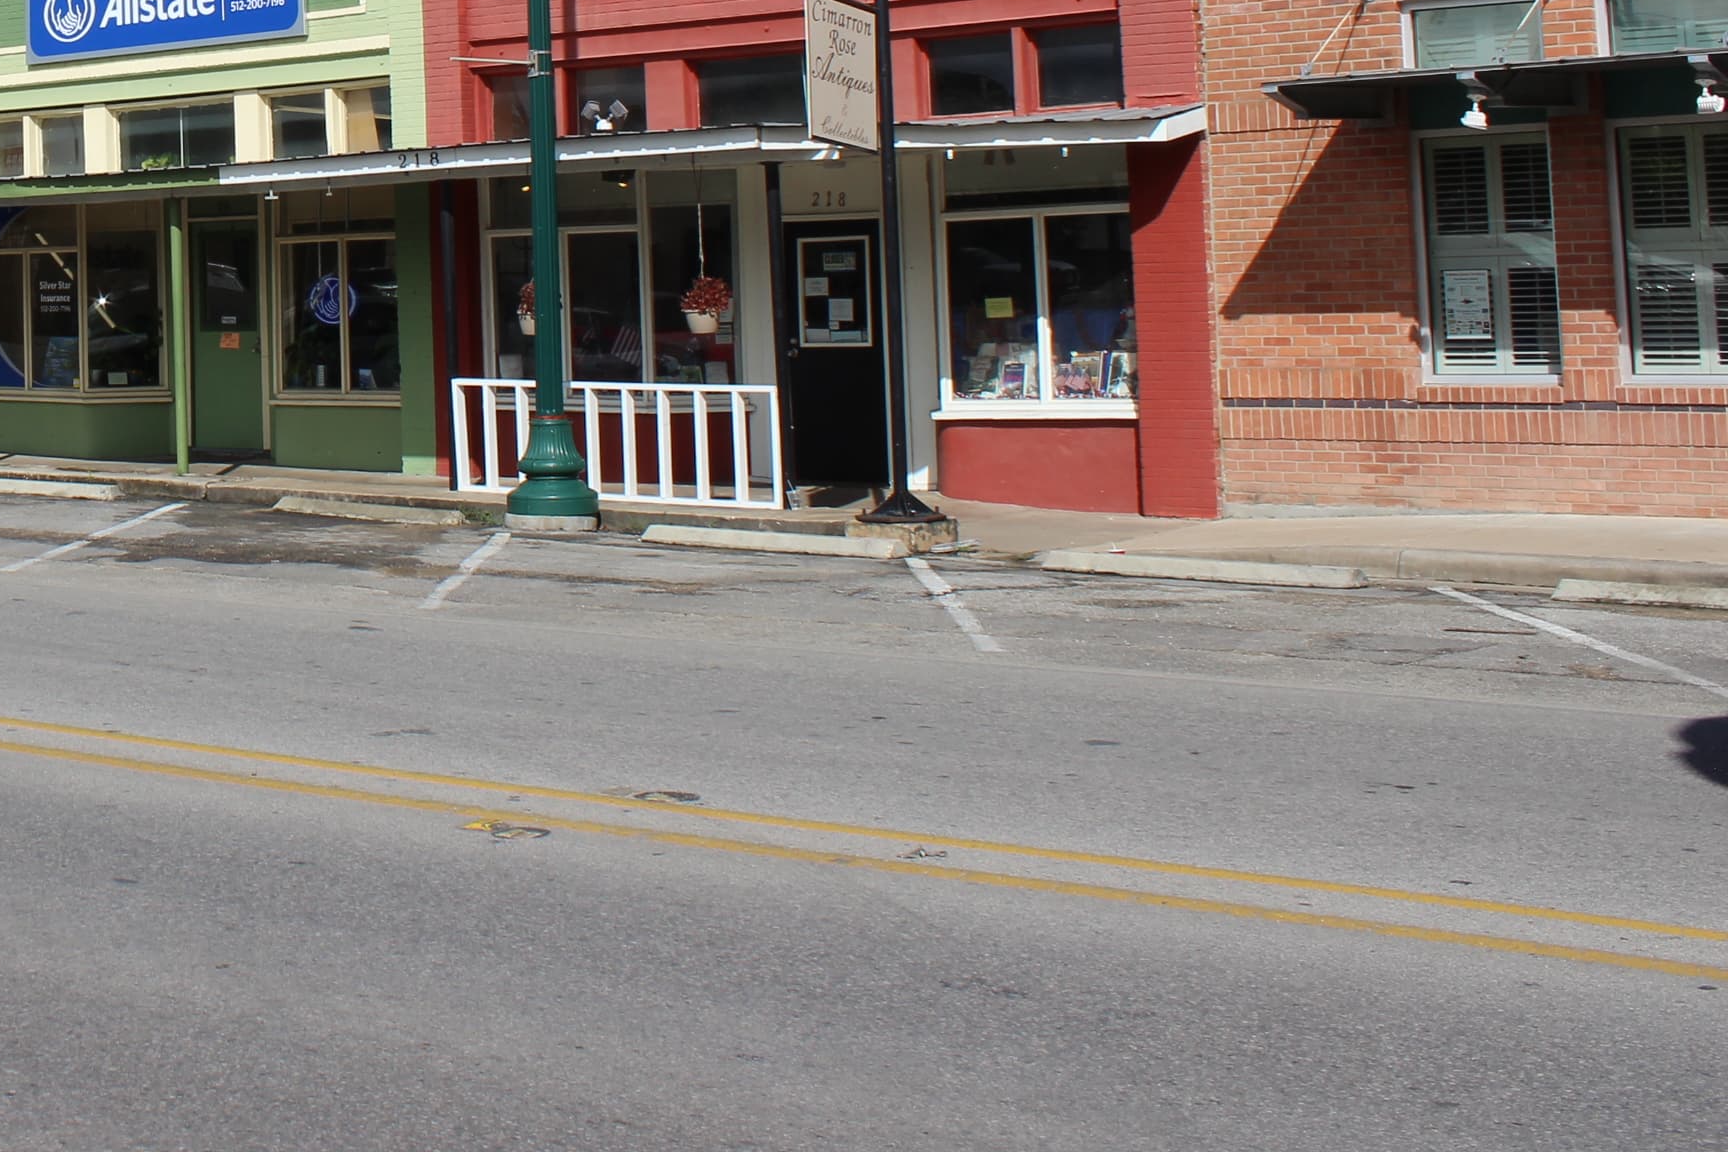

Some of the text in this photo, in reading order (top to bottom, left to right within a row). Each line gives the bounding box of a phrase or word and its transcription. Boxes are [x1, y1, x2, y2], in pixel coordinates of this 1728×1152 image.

[812, 0, 872, 37] Cimarron
[829, 29, 857, 56] Rose
[812, 52, 874, 98] Antiques
[398, 152, 439, 168] 218
[811, 191, 846, 207] 218
[39, 280, 70, 290] Silver Star
[40, 293, 70, 302] Insurance
